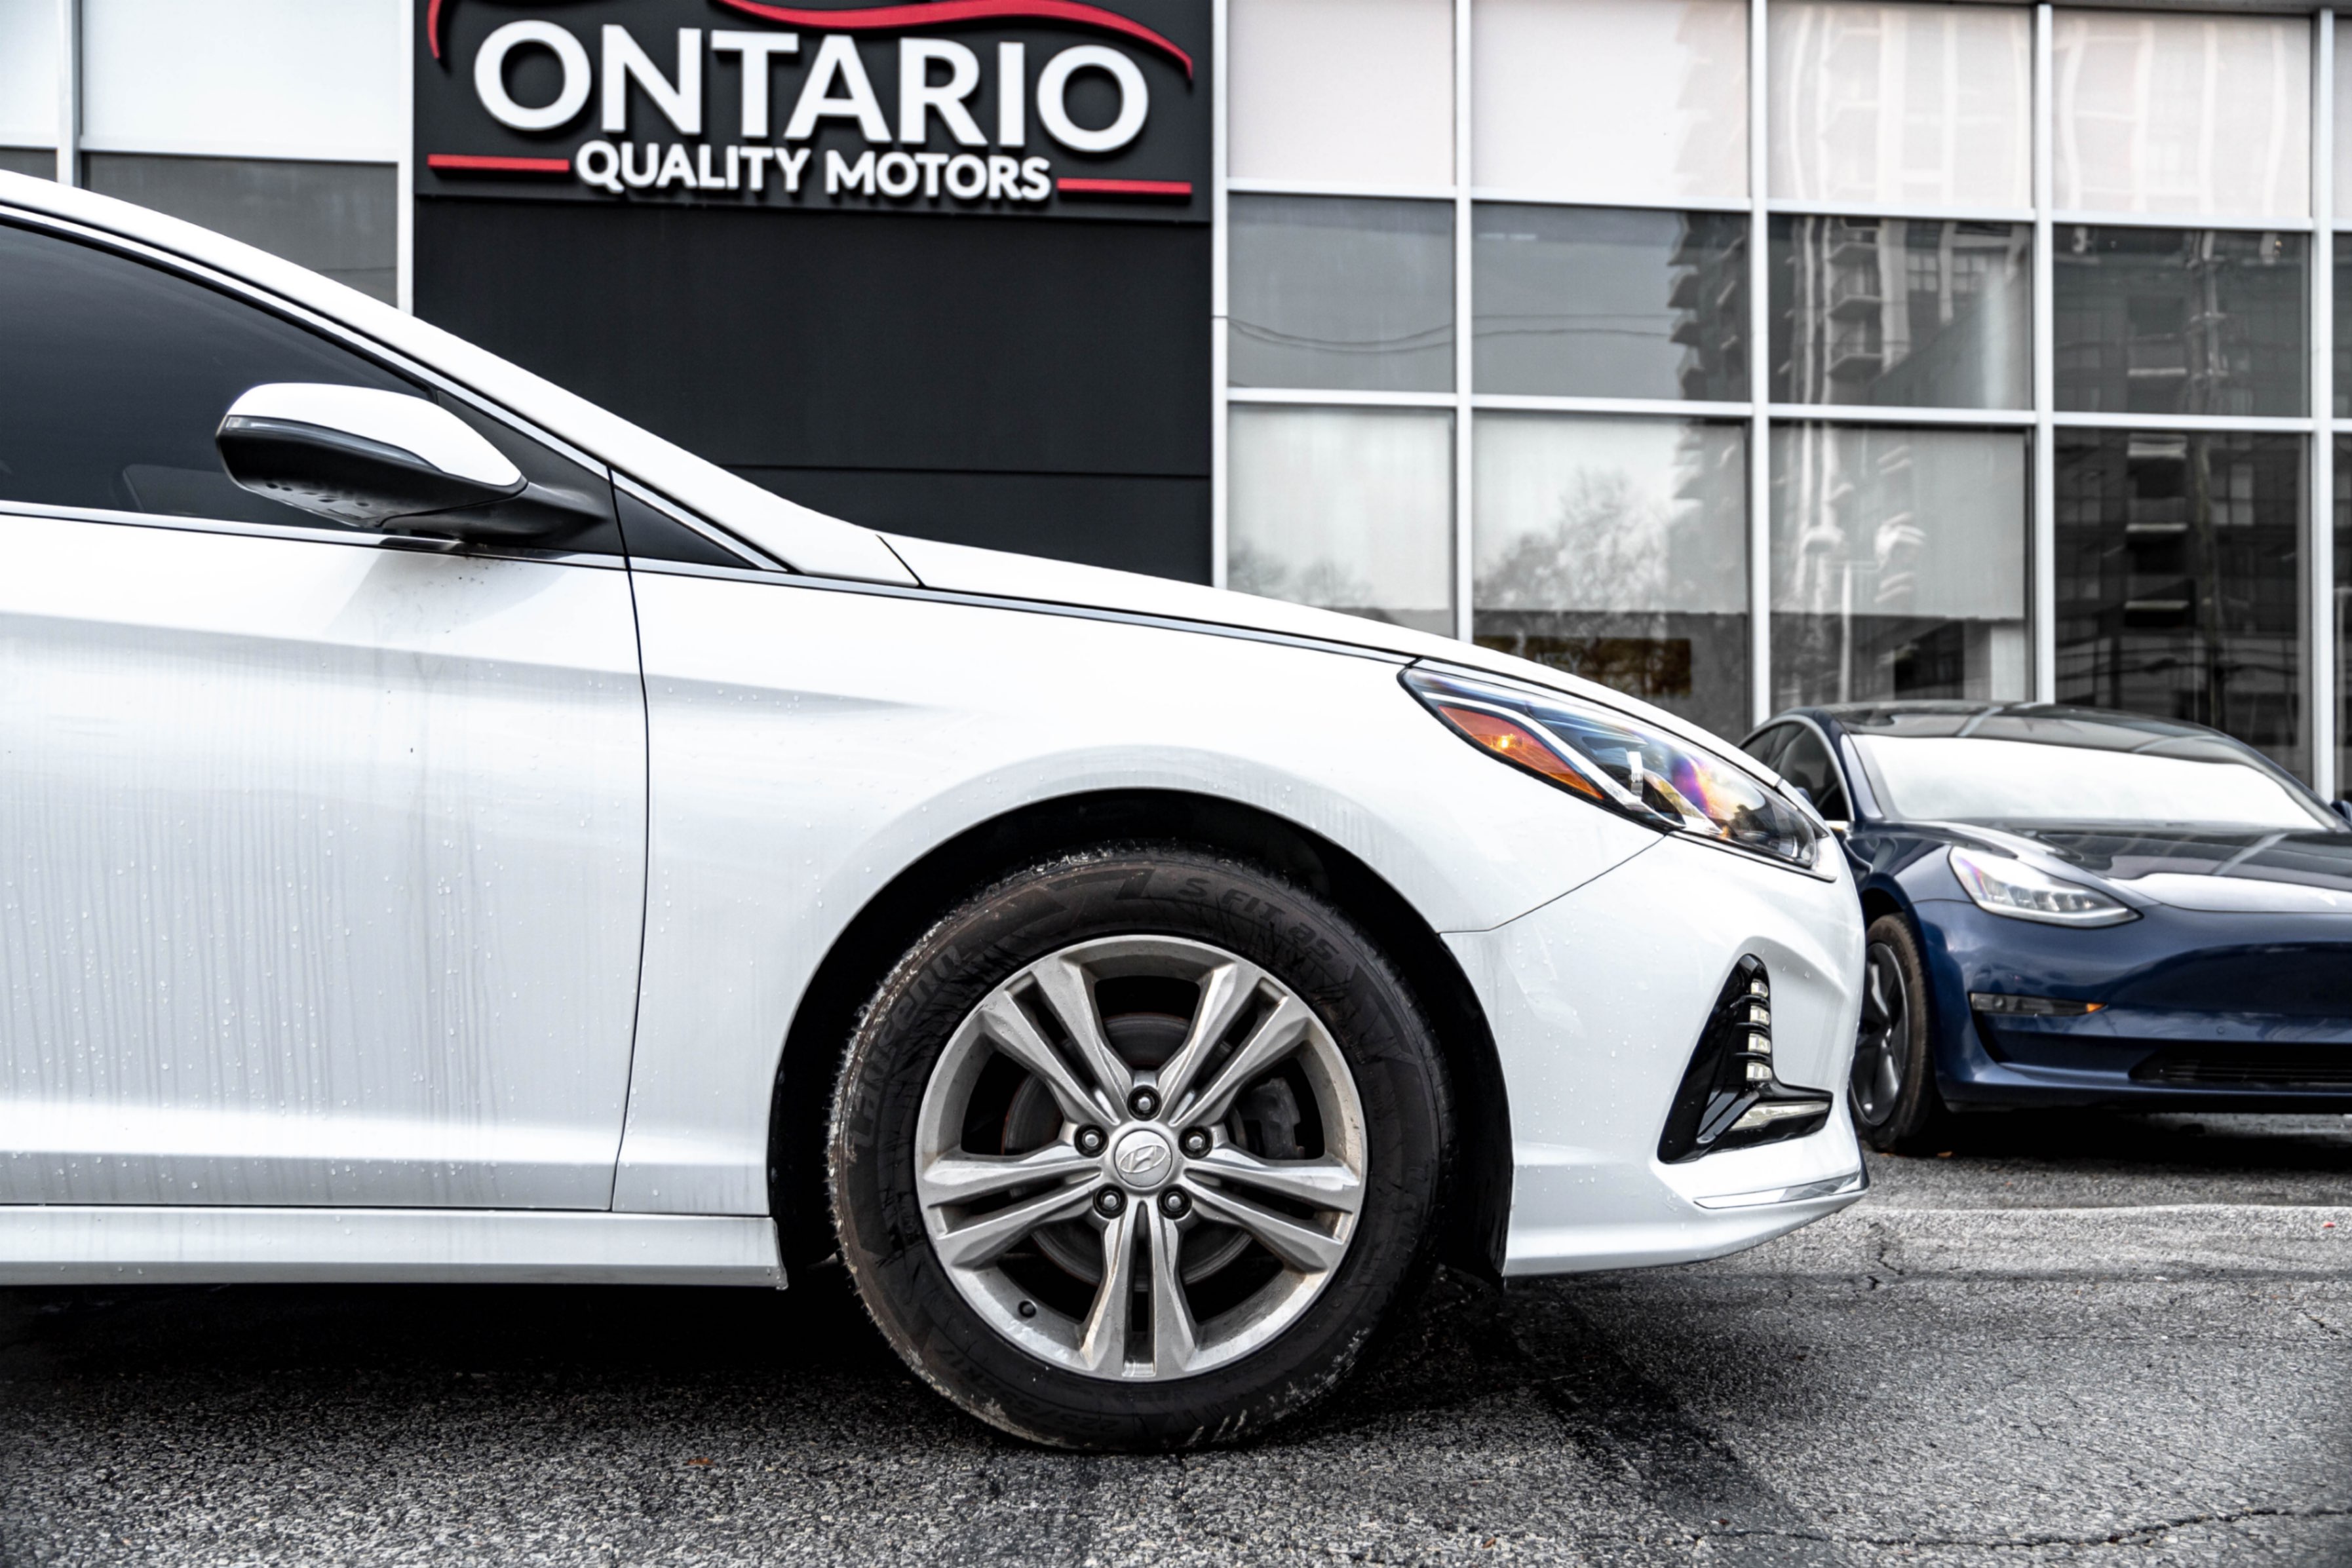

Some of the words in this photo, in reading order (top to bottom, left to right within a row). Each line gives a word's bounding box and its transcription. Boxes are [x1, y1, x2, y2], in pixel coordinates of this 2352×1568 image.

[474, 20, 1148, 153] ONTARIO
[577, 142, 811, 193] QUALITY
[826, 151, 1051, 201] MOTORS
[1179, 877, 1210, 898] S
[1222, 887, 1286, 925] FIT
